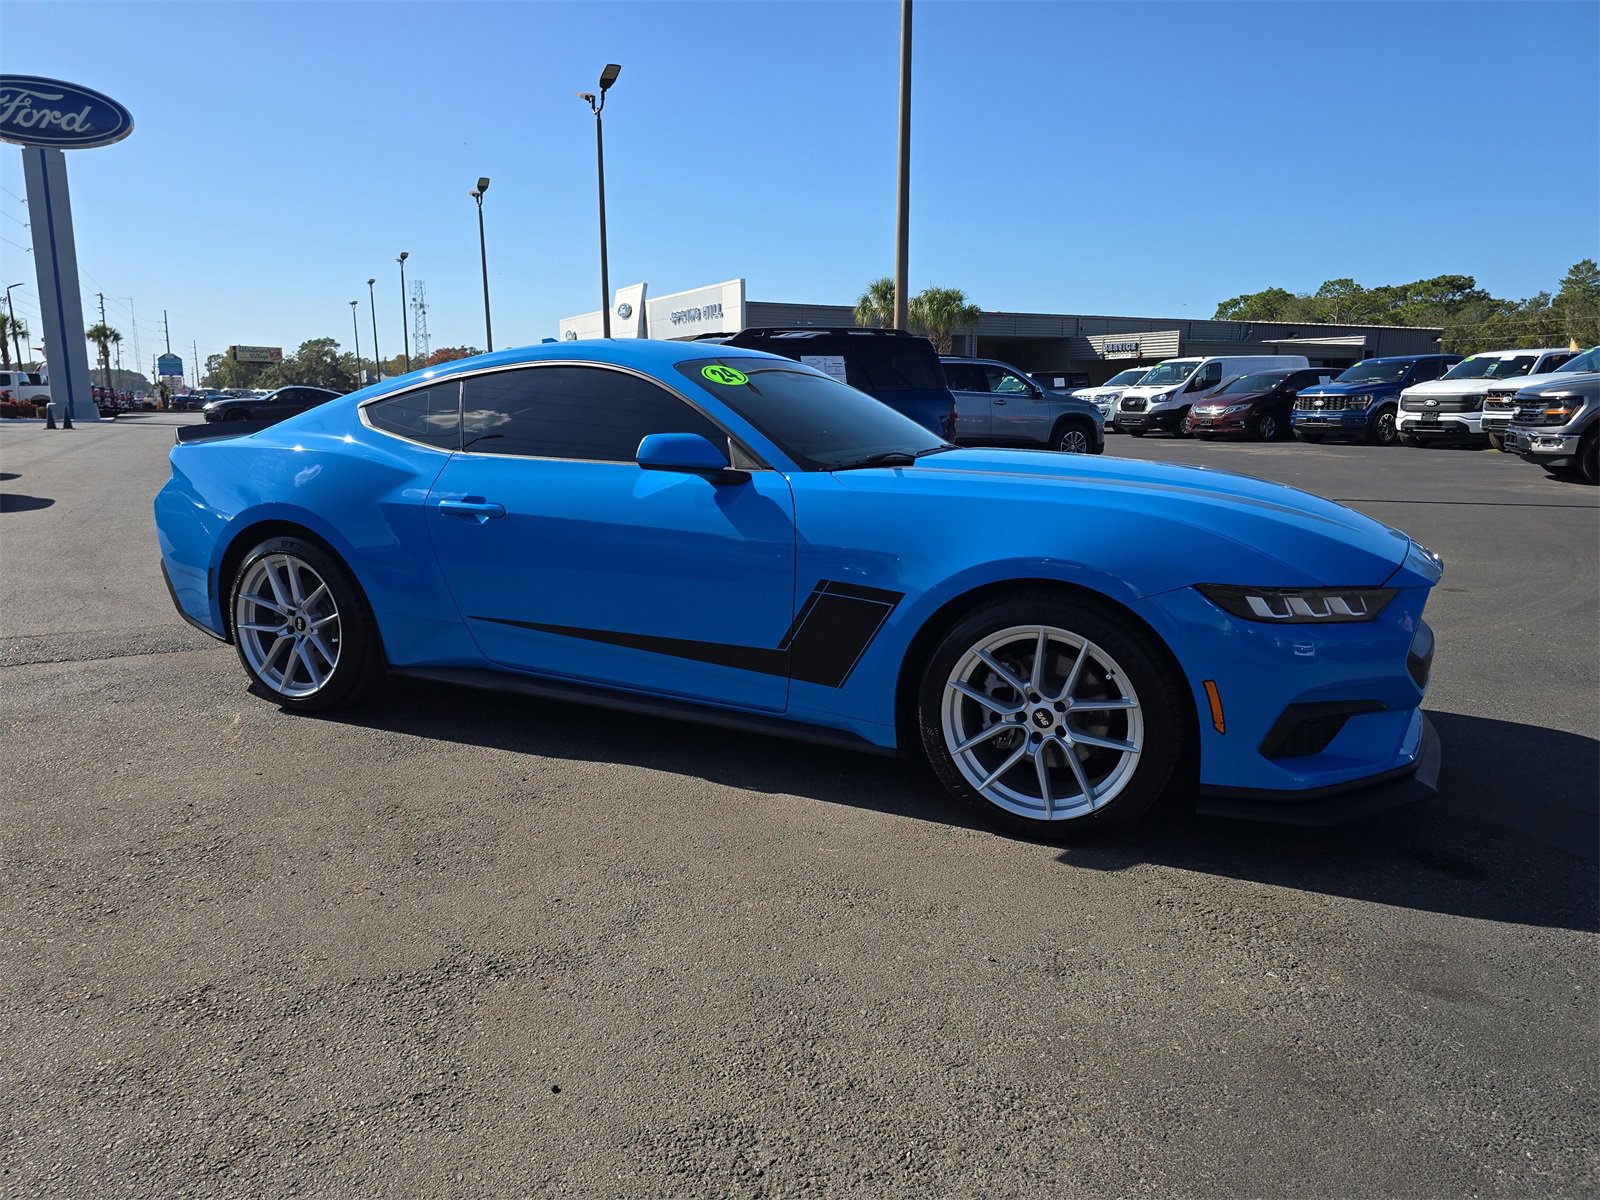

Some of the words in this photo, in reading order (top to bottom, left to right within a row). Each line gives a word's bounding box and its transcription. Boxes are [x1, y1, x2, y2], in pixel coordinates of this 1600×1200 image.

[0, 86, 93, 132] Ford
[670, 307, 701, 325] SPRING
[703, 303, 724, 320] HILL
[1103, 342, 1138, 352] SERVICE
[710, 367, 742, 383] 24
